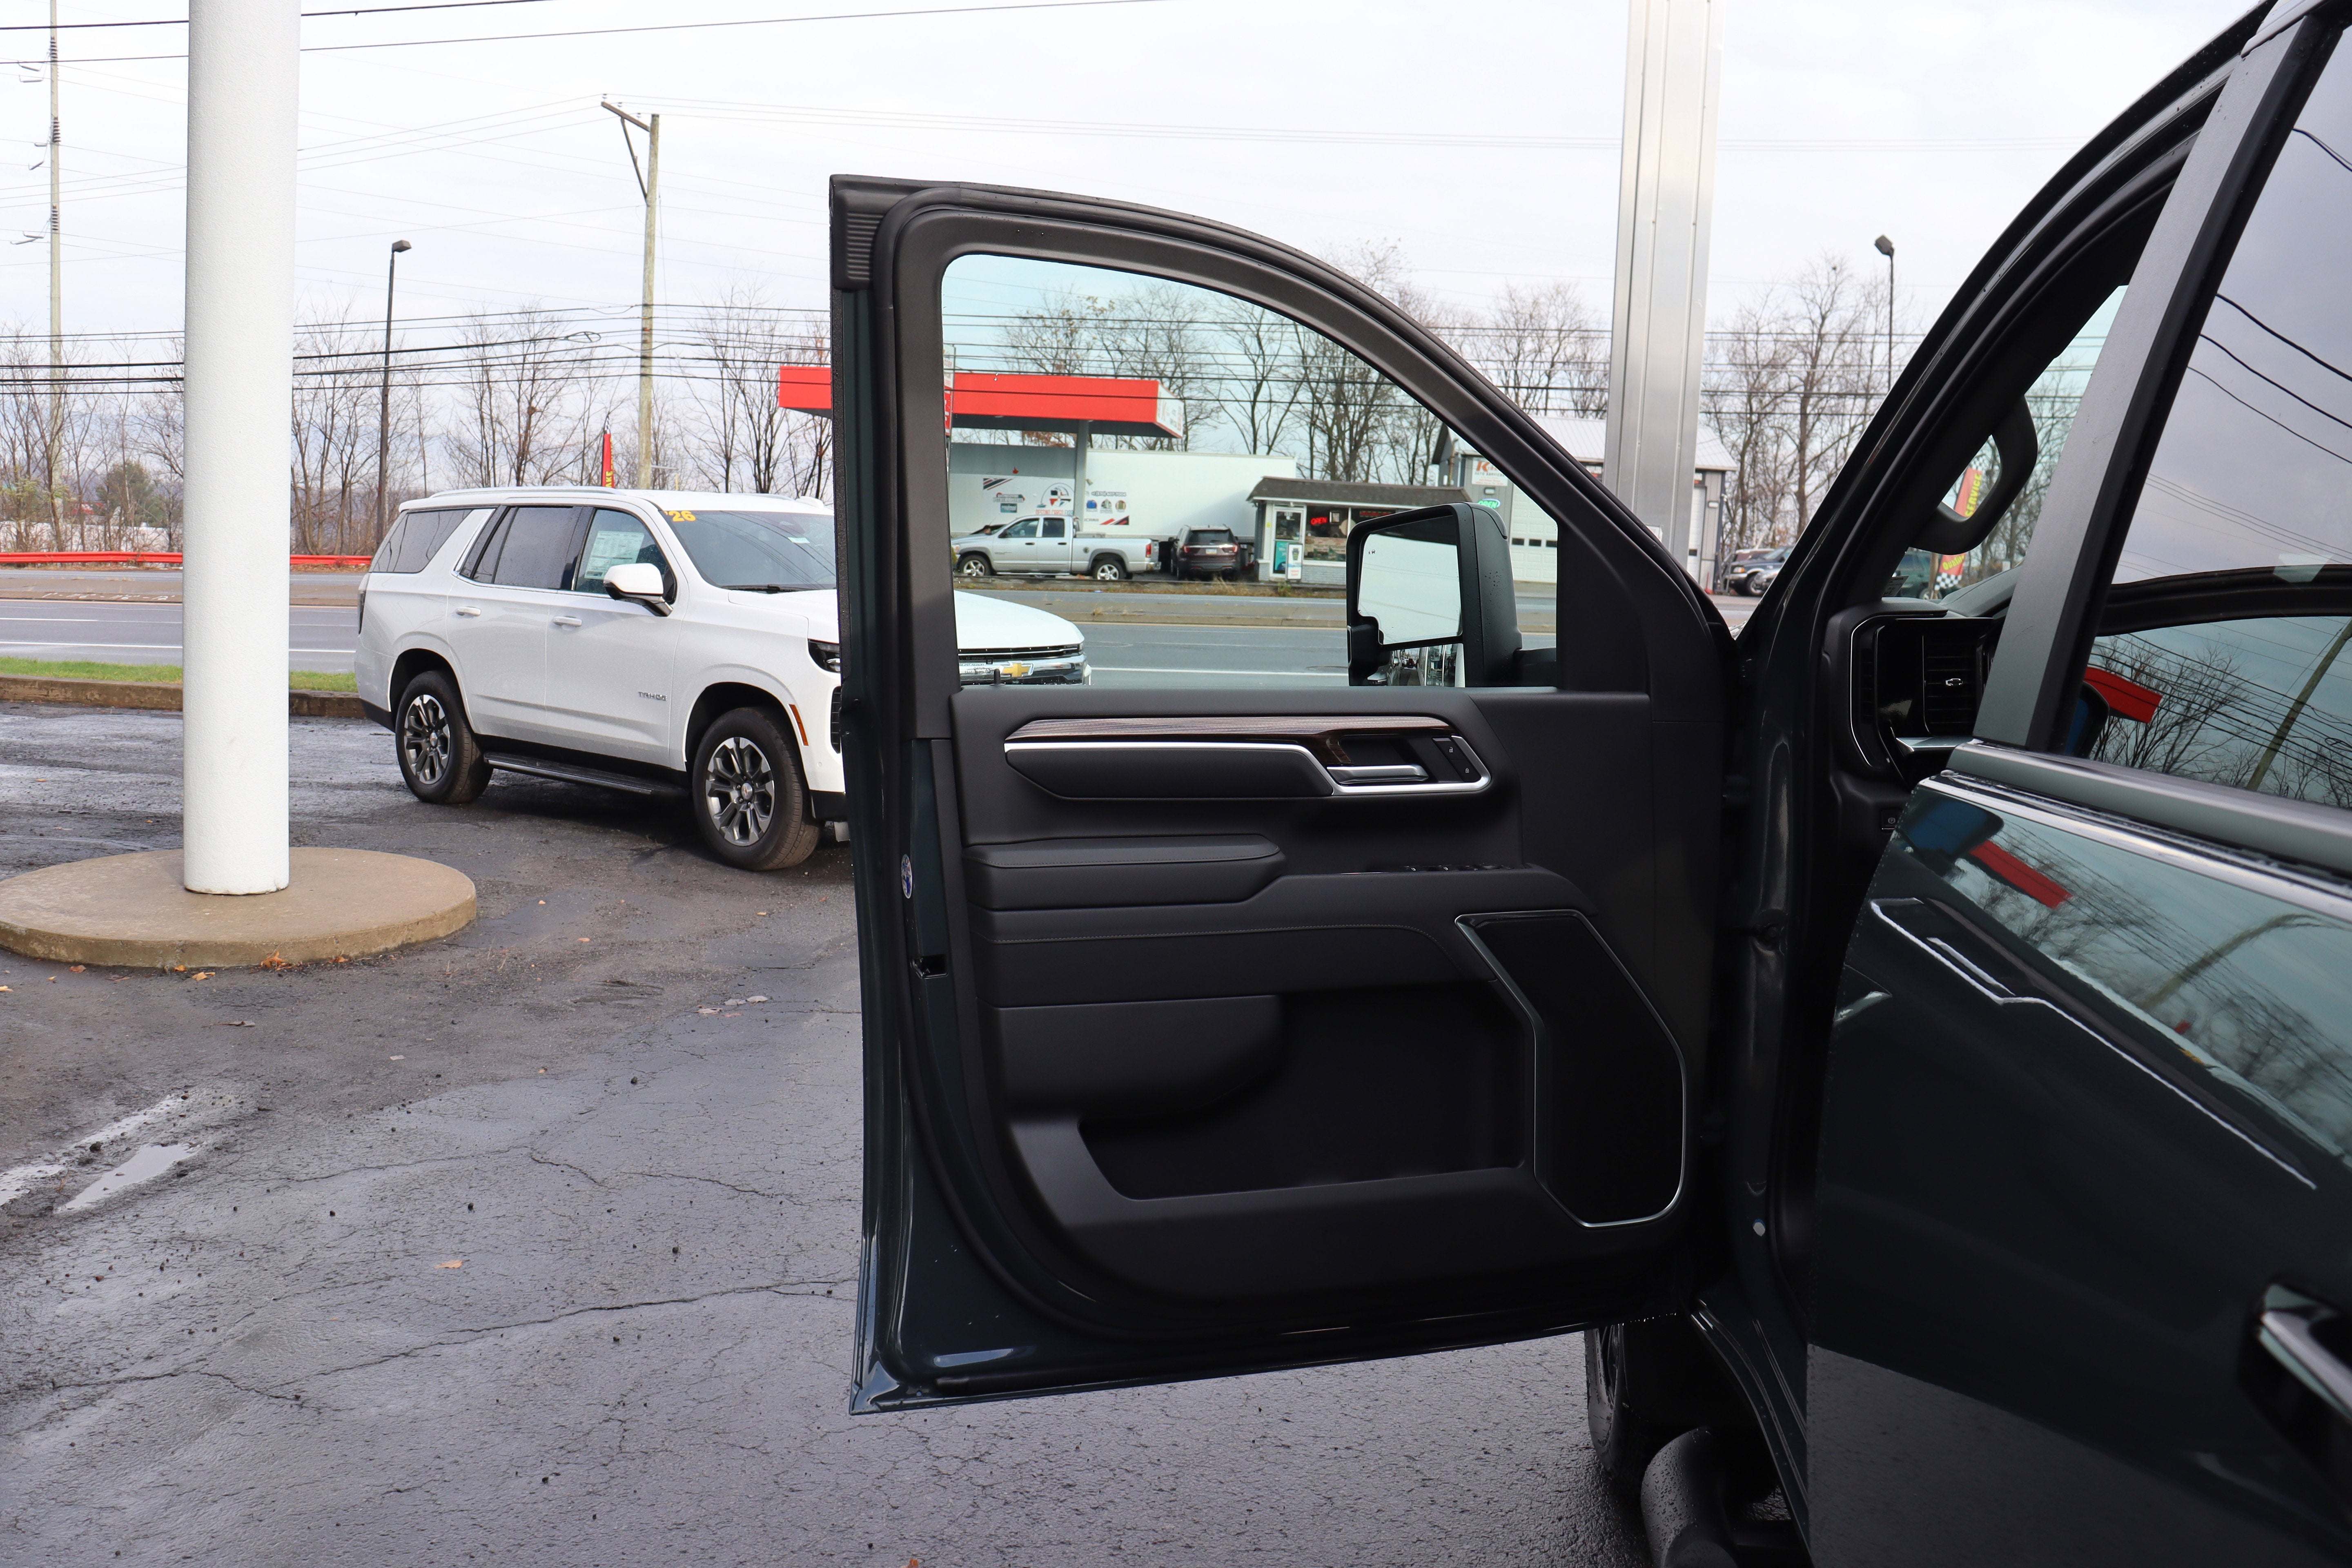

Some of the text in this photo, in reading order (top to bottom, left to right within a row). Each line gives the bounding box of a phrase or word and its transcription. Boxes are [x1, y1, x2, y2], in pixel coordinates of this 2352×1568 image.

[1965, 472, 1982, 517] SERVICE
[1478, 500, 1498, 509] OPEN
[664, 510, 696, 522] '26
[1310, 517, 1328, 526] OPEN
[638, 692, 668, 701] TAHOE
